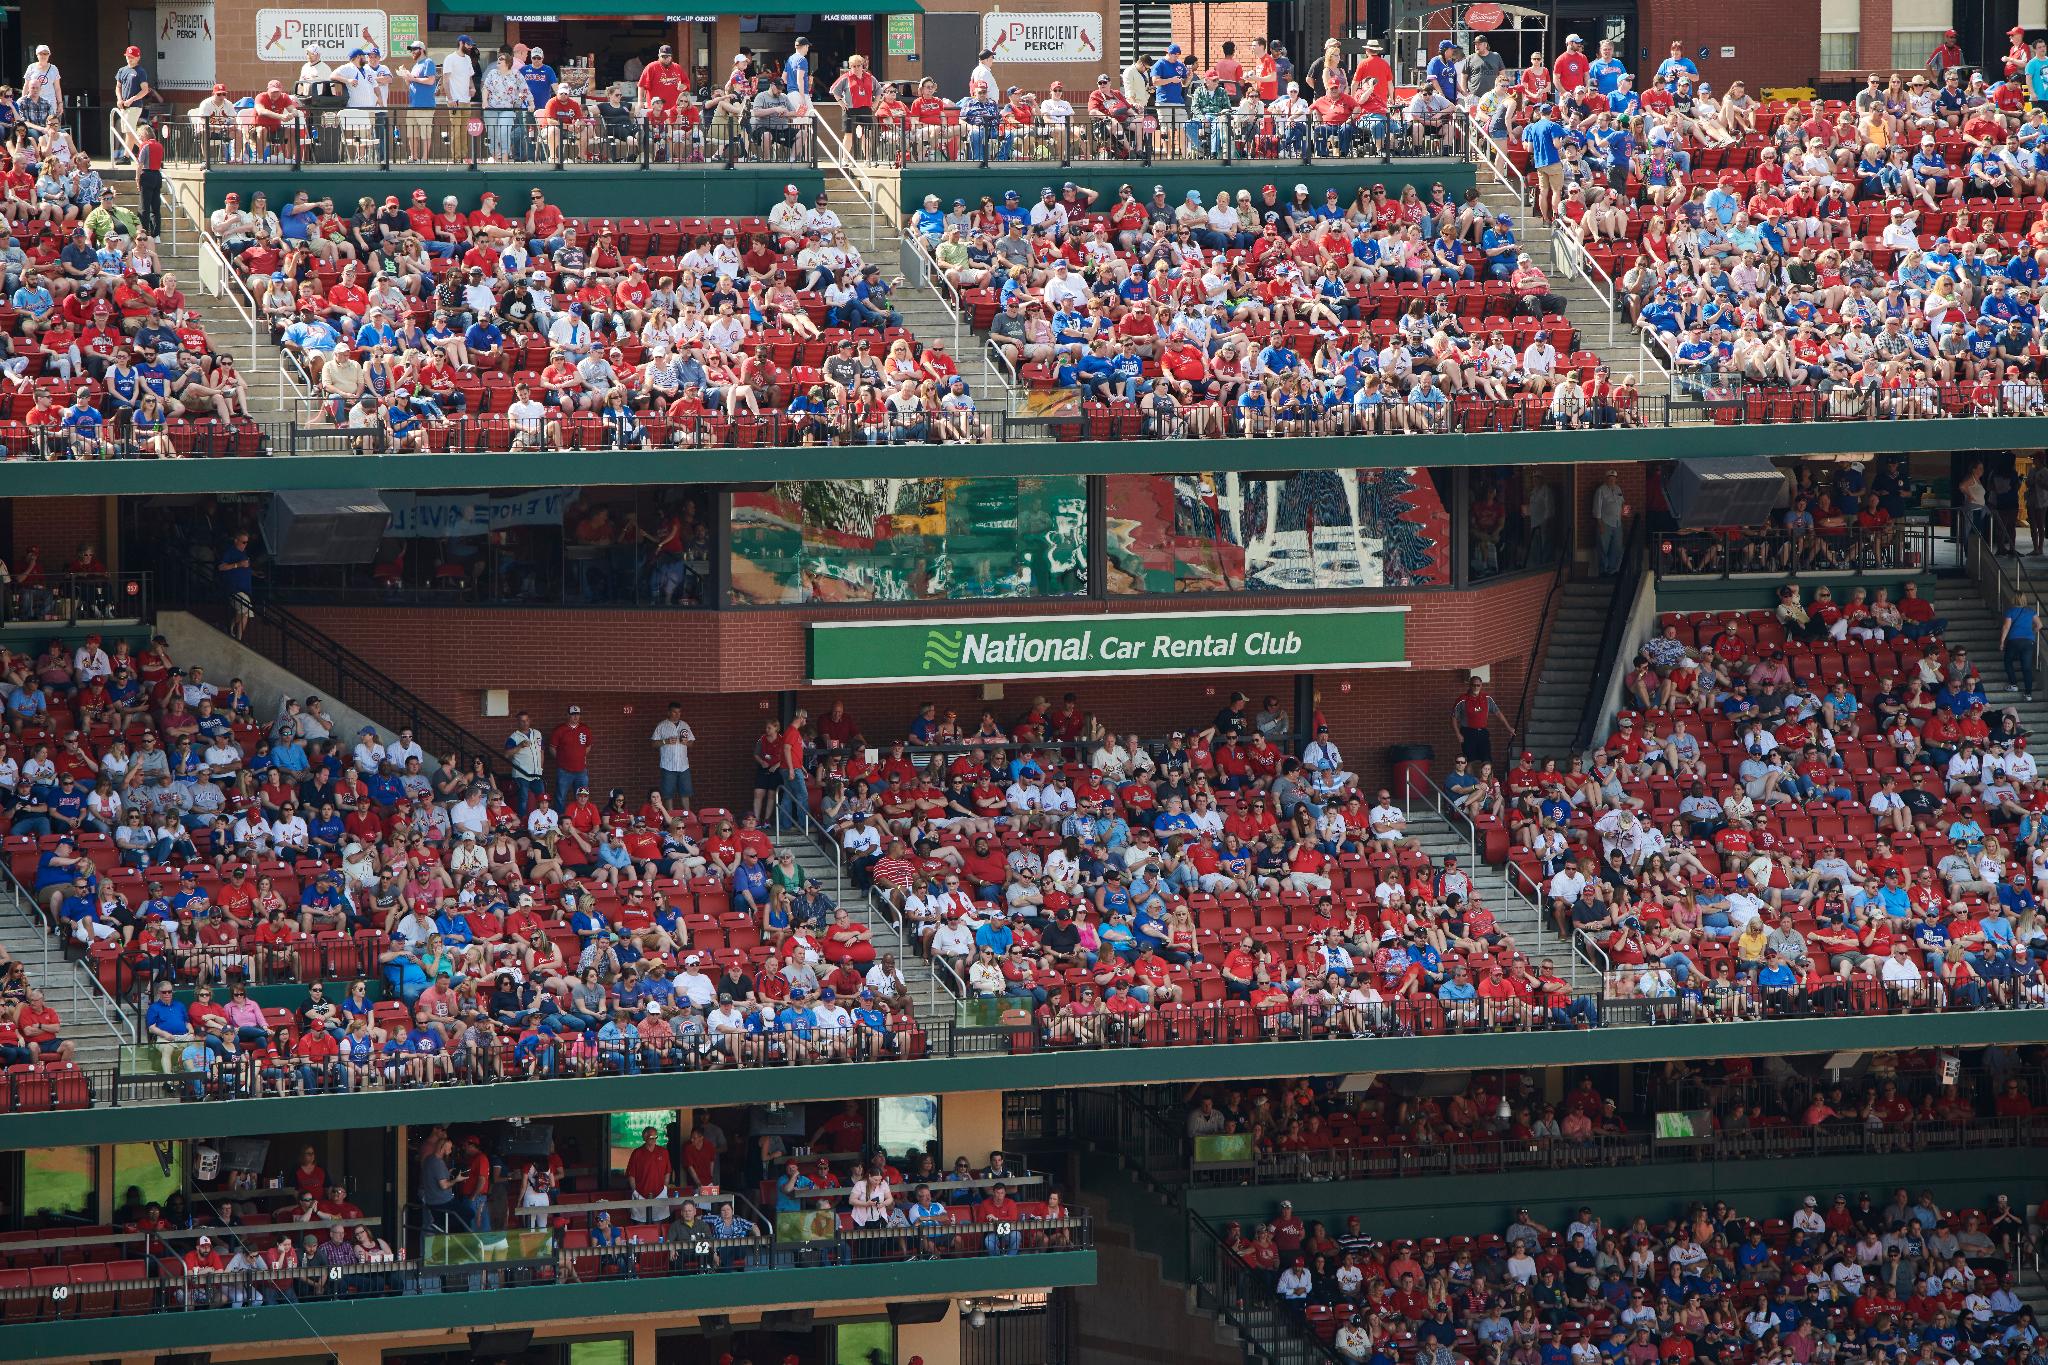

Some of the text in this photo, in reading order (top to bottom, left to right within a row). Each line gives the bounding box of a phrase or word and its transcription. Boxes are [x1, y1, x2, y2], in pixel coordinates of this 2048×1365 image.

[170, 12, 204, 29] PERFICIENT
[177, 30, 196, 39] PERCH
[284, 20, 359, 39] PERFICIENT
[1010, 23, 1078, 41] PERFICIENT
[301, 40, 345, 49] PERCH
[1024, 42, 1063, 51] PERCH
[468, 122, 481, 132] 357
[1143, 120, 1156, 130] 358
[961, 630, 1302, 664] National Car Rental Club
[997, 1222, 1010, 1235] 63
[695, 1241, 710, 1254] 62
[329, 1266, 342, 1280] 61
[52, 1286, 68, 1301] 60
